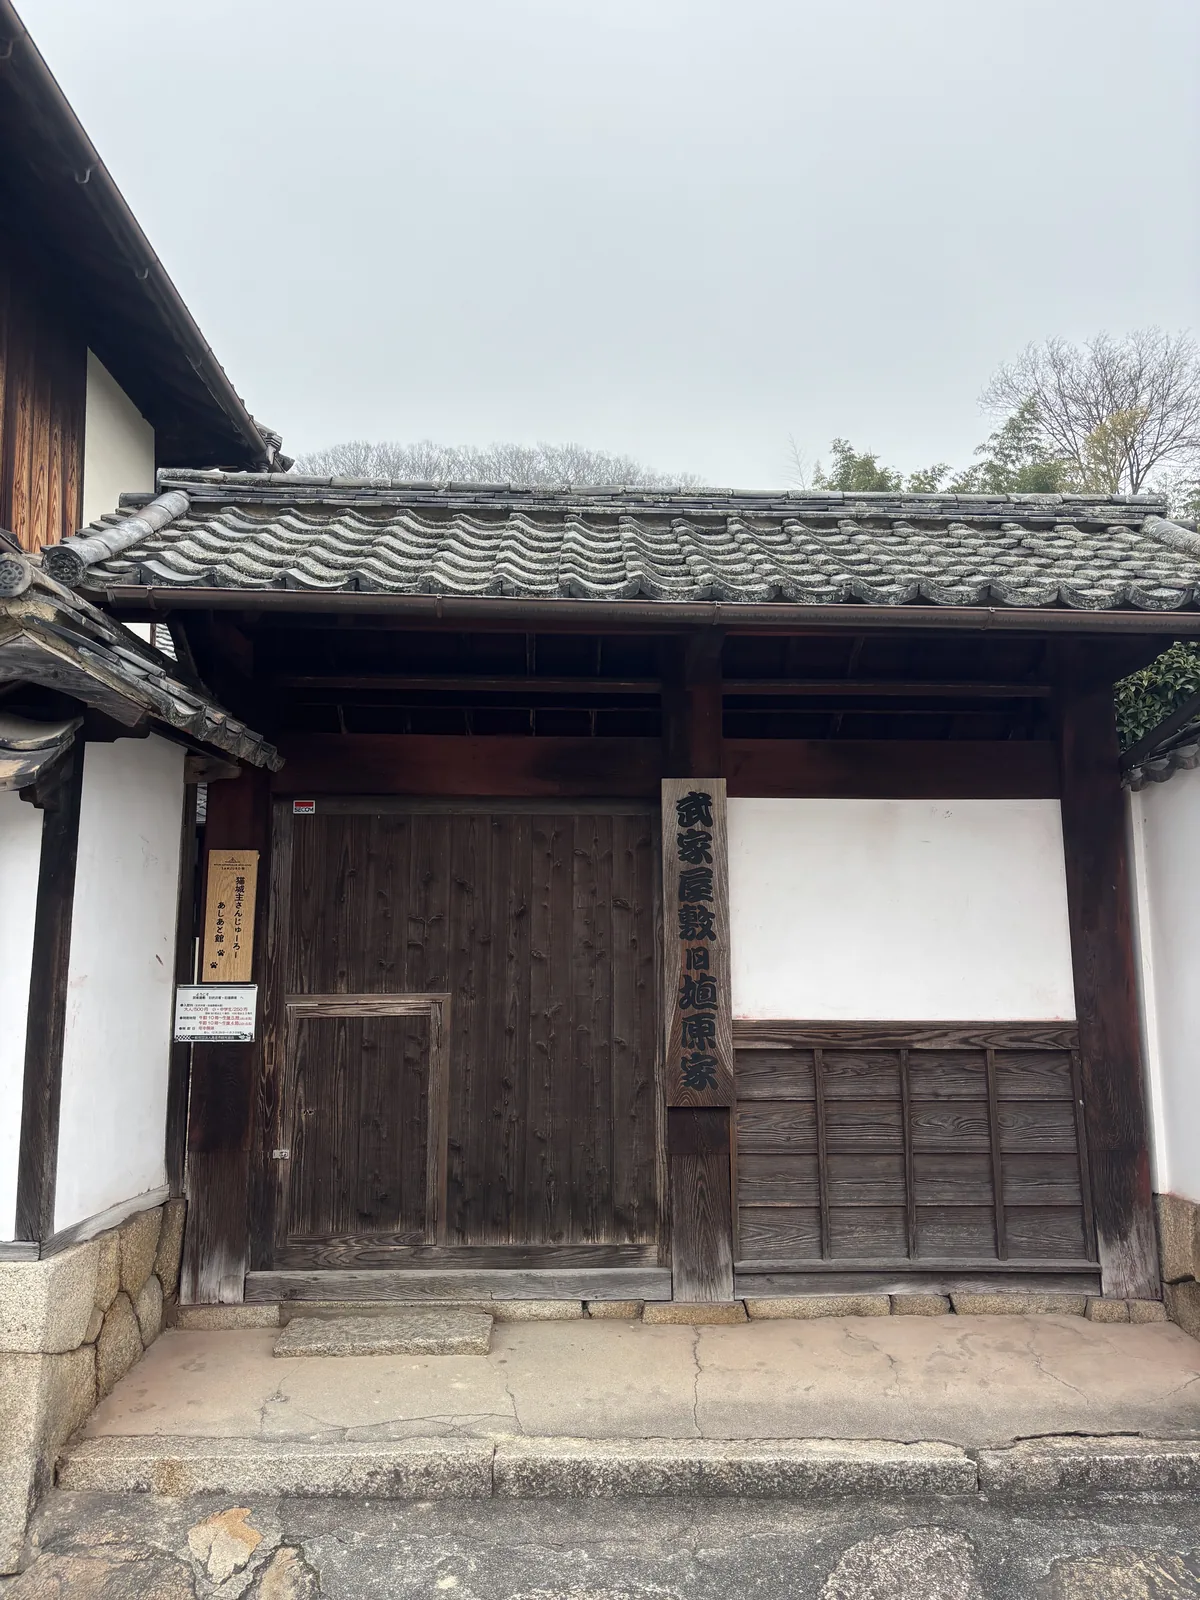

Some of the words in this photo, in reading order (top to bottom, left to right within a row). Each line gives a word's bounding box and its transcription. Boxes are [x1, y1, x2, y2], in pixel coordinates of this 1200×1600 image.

[214, 901, 226, 943] あしあと館
